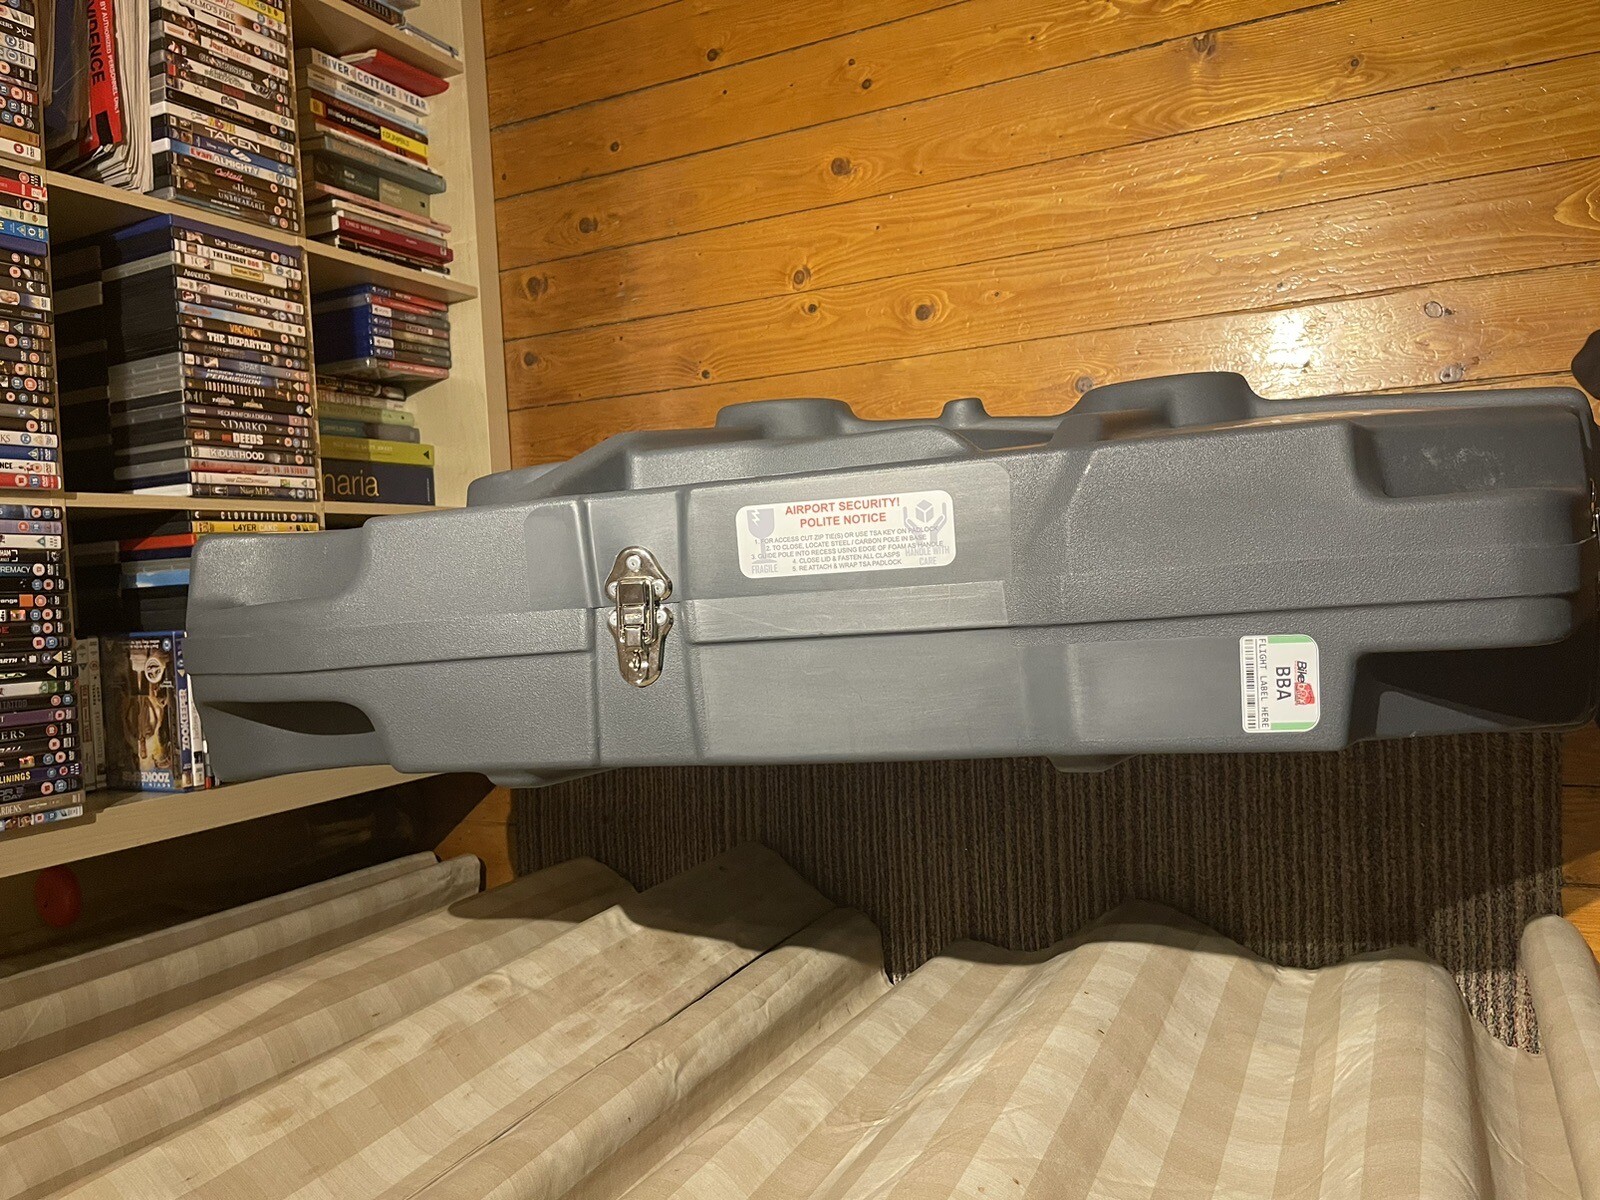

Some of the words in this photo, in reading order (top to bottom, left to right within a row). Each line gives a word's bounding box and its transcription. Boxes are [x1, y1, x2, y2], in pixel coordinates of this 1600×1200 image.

[101, 12, 112, 54] AUTHORIZED
[108, 54, 118, 96] PERSONNEL
[322, 56, 349, 77] RIVER
[357, 71, 397, 97] COTTAGE
[403, 92, 426, 110] YEAR
[204, 126, 260, 154] TAKEN
[190, 146, 212, 160] Evan
[213, 154, 259, 175] ALMIGHTY
[218, 192, 266, 211] UNBREAKABLE
[223, 289, 272, 306] notebook
[229, 323, 261, 338] VACANCY
[206, 331, 225, 344] THE
[227, 334, 271, 352] DEPARTED
[239, 361, 266, 374] SPACE
[205, 372, 261, 386] PERMISSION
[204, 380, 252, 396] INDEPENDENCE
[253, 387, 265, 398] DAY
[232, 432, 264, 445] DEEDS
[785, 502, 835, 515] AIRPORT
[838, 497, 900, 511] SECURITY!
[220, 511, 288, 521] CLOVERFIELD
[800, 516, 840, 528] POLITE
[843, 512, 886, 525] NOTICE
[800, 534, 813, 542] CUT
[814, 533, 824, 541] ZIP
[825, 532, 844, 541] TIE(S)
[908, 526, 938, 534] PADLOCK
[805, 541, 830, 549] LOCATE
[831, 539, 851, 547] STEEL
[854, 537, 882, 545] CARBON
[909, 533, 927, 541] BASE
[811, 548, 837, 556] RECESS
[837, 546, 857, 554] USING
[917, 540, 944, 548] HANDLE
[838, 554, 862, 562] FASTEN
[875, 551, 900, 559] CLASPS
[905, 547, 931, 557] HANDLE
[933, 545, 950, 555] WITH
[751, 564, 778, 574] FRAGILE
[839, 561, 858, 569] WRAP
[872, 559, 902, 567] PADLOCK
[919, 557, 937, 566] CARE
[1258, 638, 1267, 670] FLIGHT
[1296, 660, 1308, 684] Bike
[1260, 675, 1269, 701] LABEL
[1275, 666, 1292, 701] BBA
[179, 688, 191, 750] ZOOKEEPER
[1261, 706, 1270, 728] HERE
